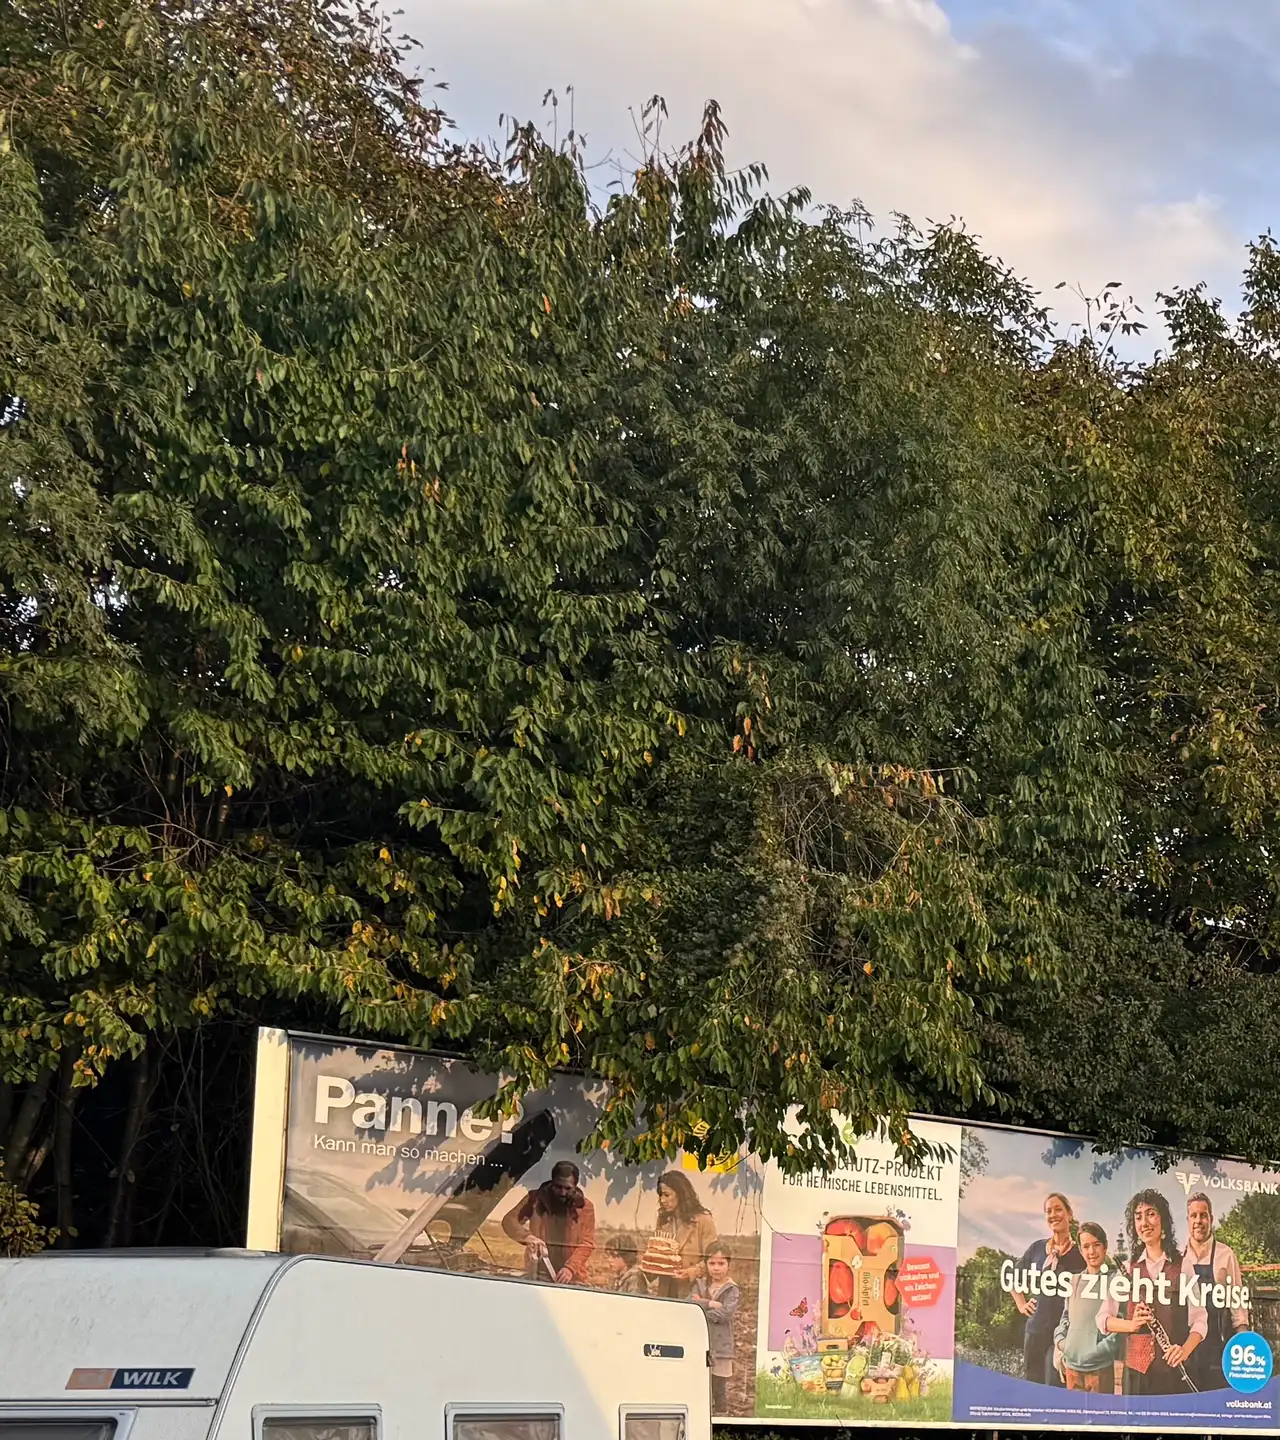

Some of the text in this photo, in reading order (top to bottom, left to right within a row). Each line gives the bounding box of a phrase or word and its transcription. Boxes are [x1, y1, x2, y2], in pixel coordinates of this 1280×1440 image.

[314, 1134, 356, 1153] Kann
[361, 1142, 396, 1157] man
[400, 1147, 420, 1159] so
[424, 1147, 486, 1166] machen
[806, 1175, 862, 1193] HEIMISCHE
[864, 1180, 943, 1201] LEBENSMITTEL.
[1203, 1175, 1279, 1196] VOLKSBANK
[1000, 1259, 1252, 1310] Gutes zieht Kreise.
[1230, 1344, 1267, 1366] 96%
[123, 1371, 182, 1386] WILK
[1225, 1399, 1273, 1410] volksbank.at
